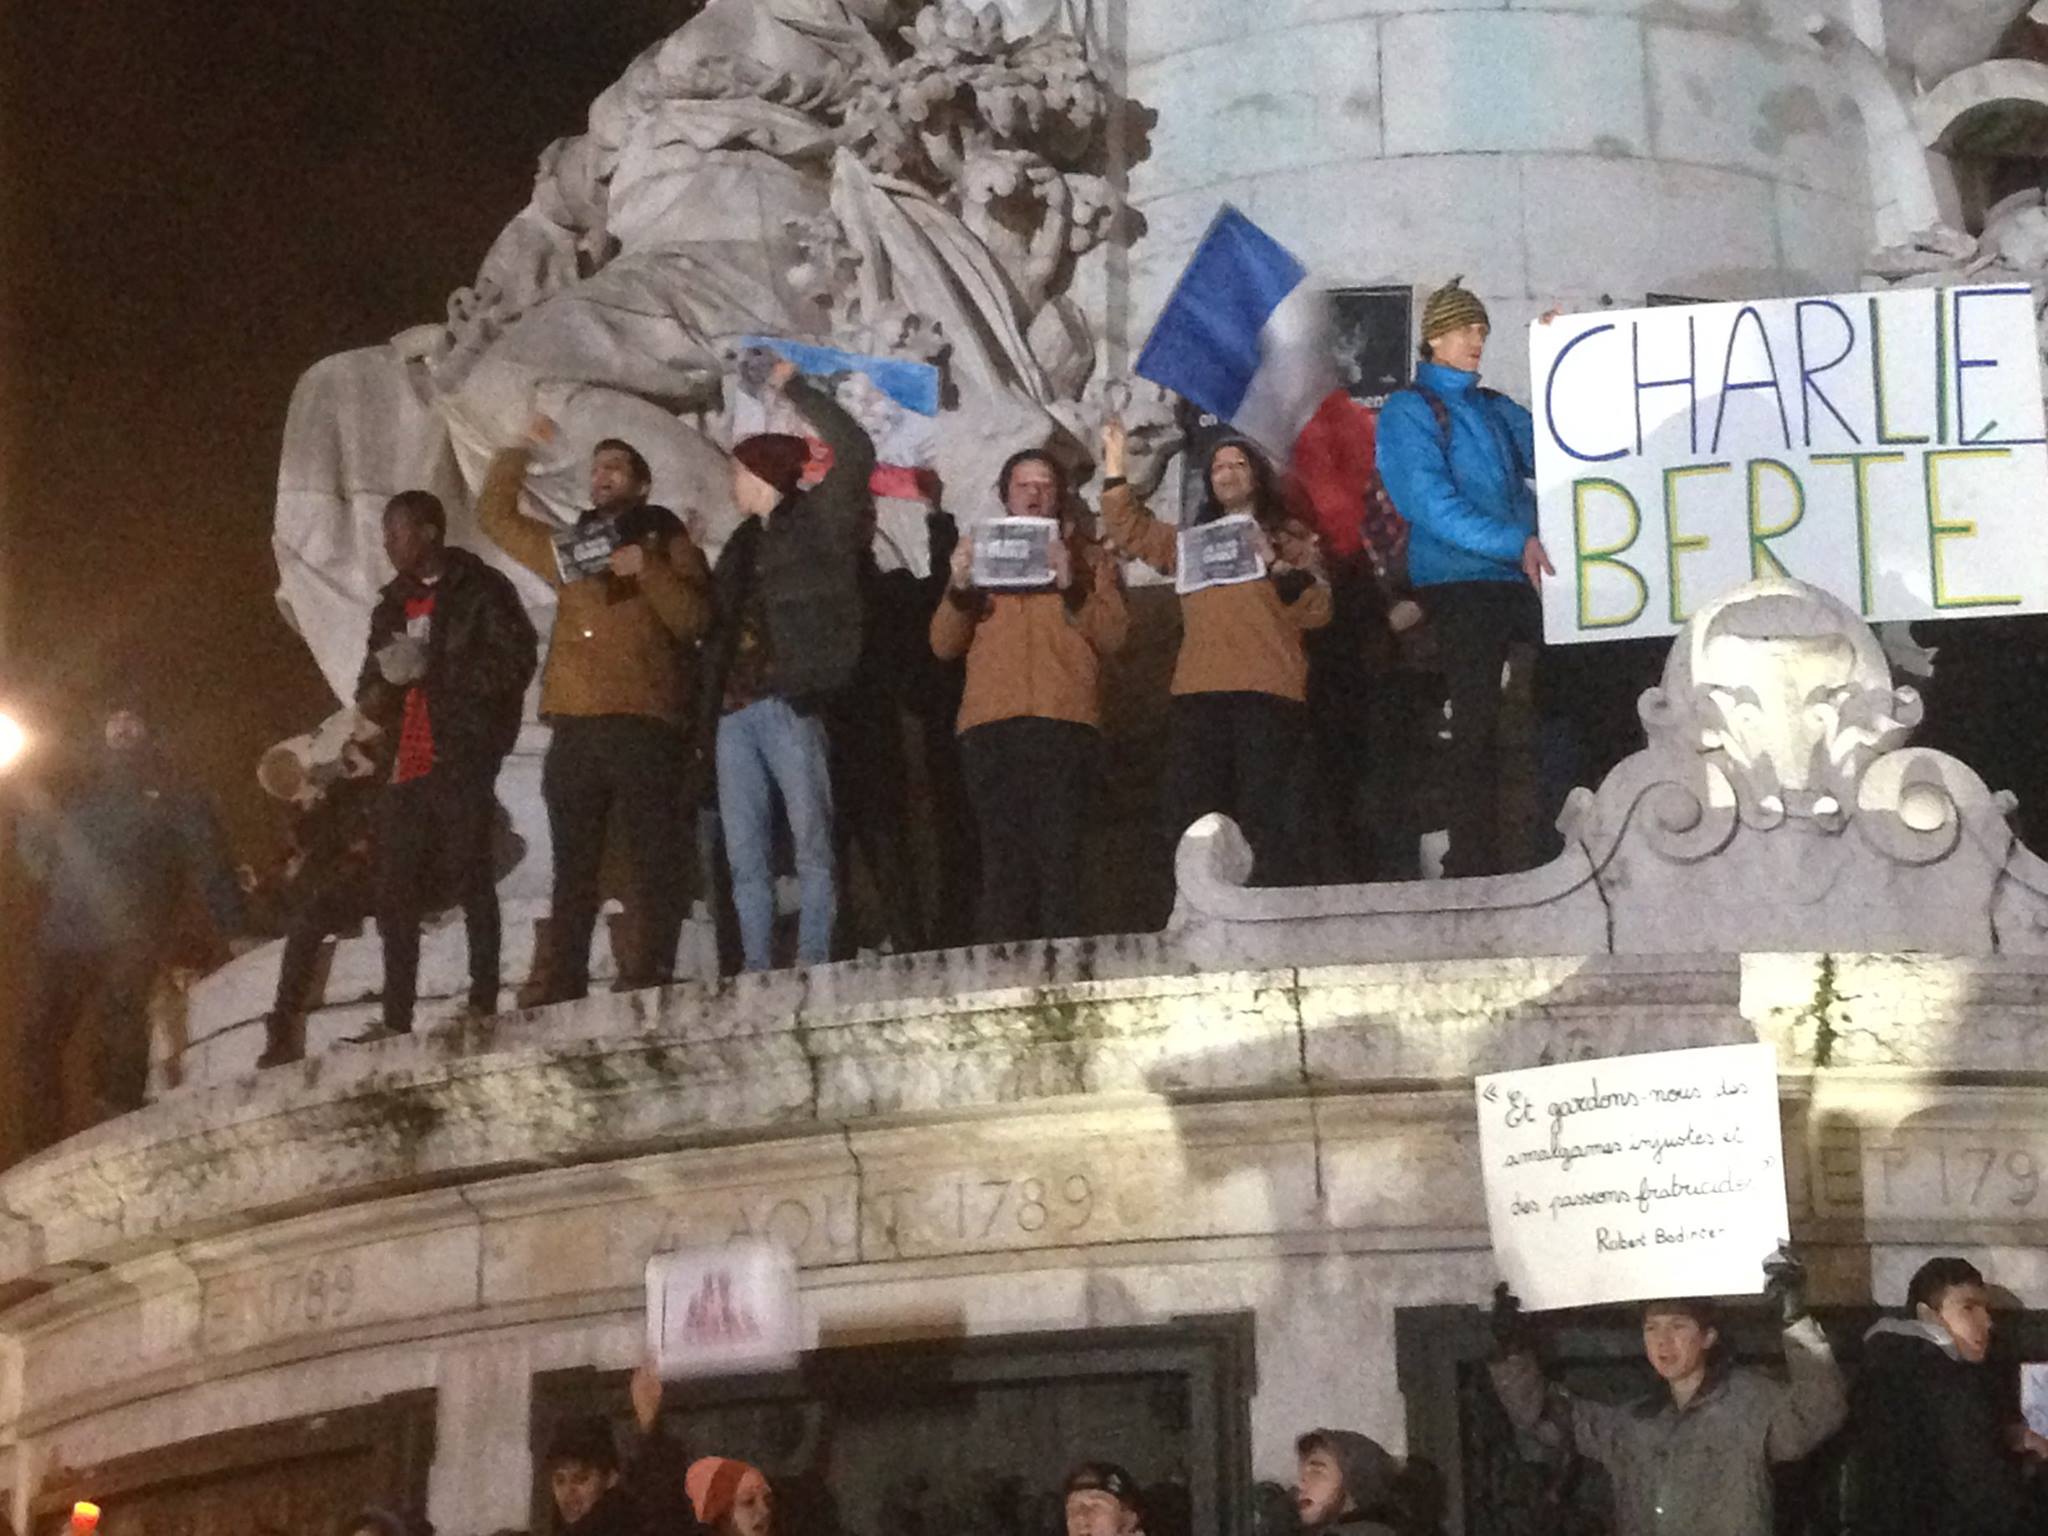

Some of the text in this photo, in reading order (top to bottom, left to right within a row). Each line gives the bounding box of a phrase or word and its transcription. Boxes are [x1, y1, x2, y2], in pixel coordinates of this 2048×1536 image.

[1546, 288, 2046, 462] CHARLIE
[1504, 1089, 1537, 1128] Et
[1715, 1077, 1749, 1097] des
[1502, 1121, 1745, 1171] amalgames injustes et
[956, 1174, 1094, 1239] 1789
[1511, 1192, 1540, 1216] des
[1549, 1189, 1630, 1221] passions
[1596, 1226, 1646, 1253] Robert
